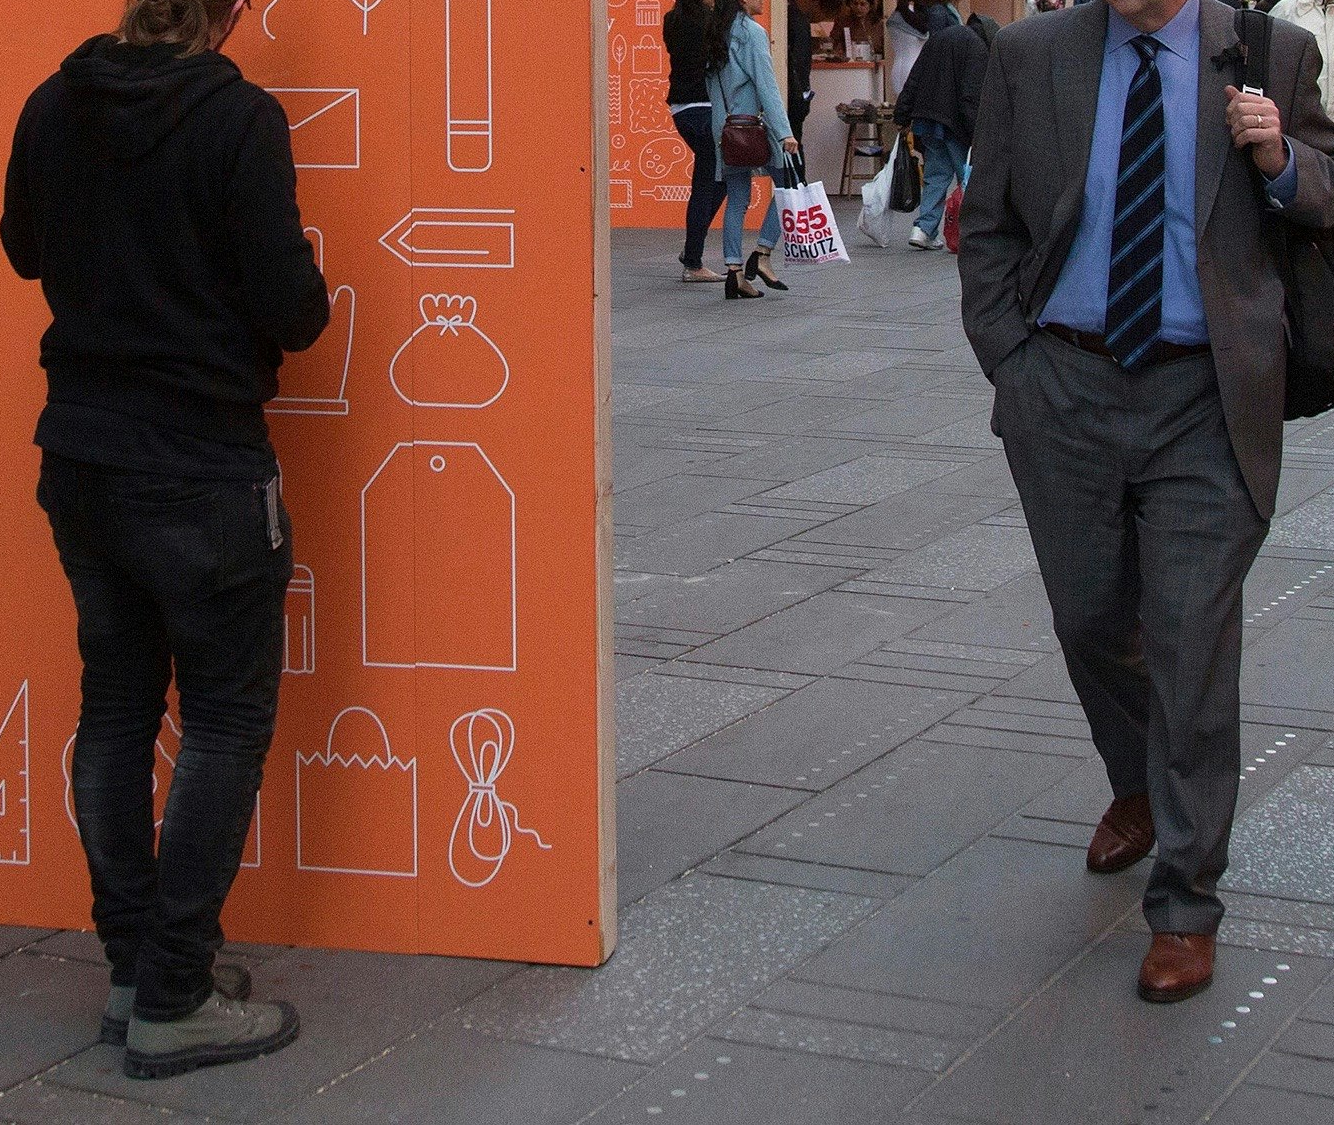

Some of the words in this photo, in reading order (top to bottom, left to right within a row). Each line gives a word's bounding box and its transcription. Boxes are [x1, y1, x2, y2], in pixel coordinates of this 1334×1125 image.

[782, 204, 828, 234] 655
[783, 227, 833, 244] MADISON
[784, 237, 838, 258] SCHUTZ
